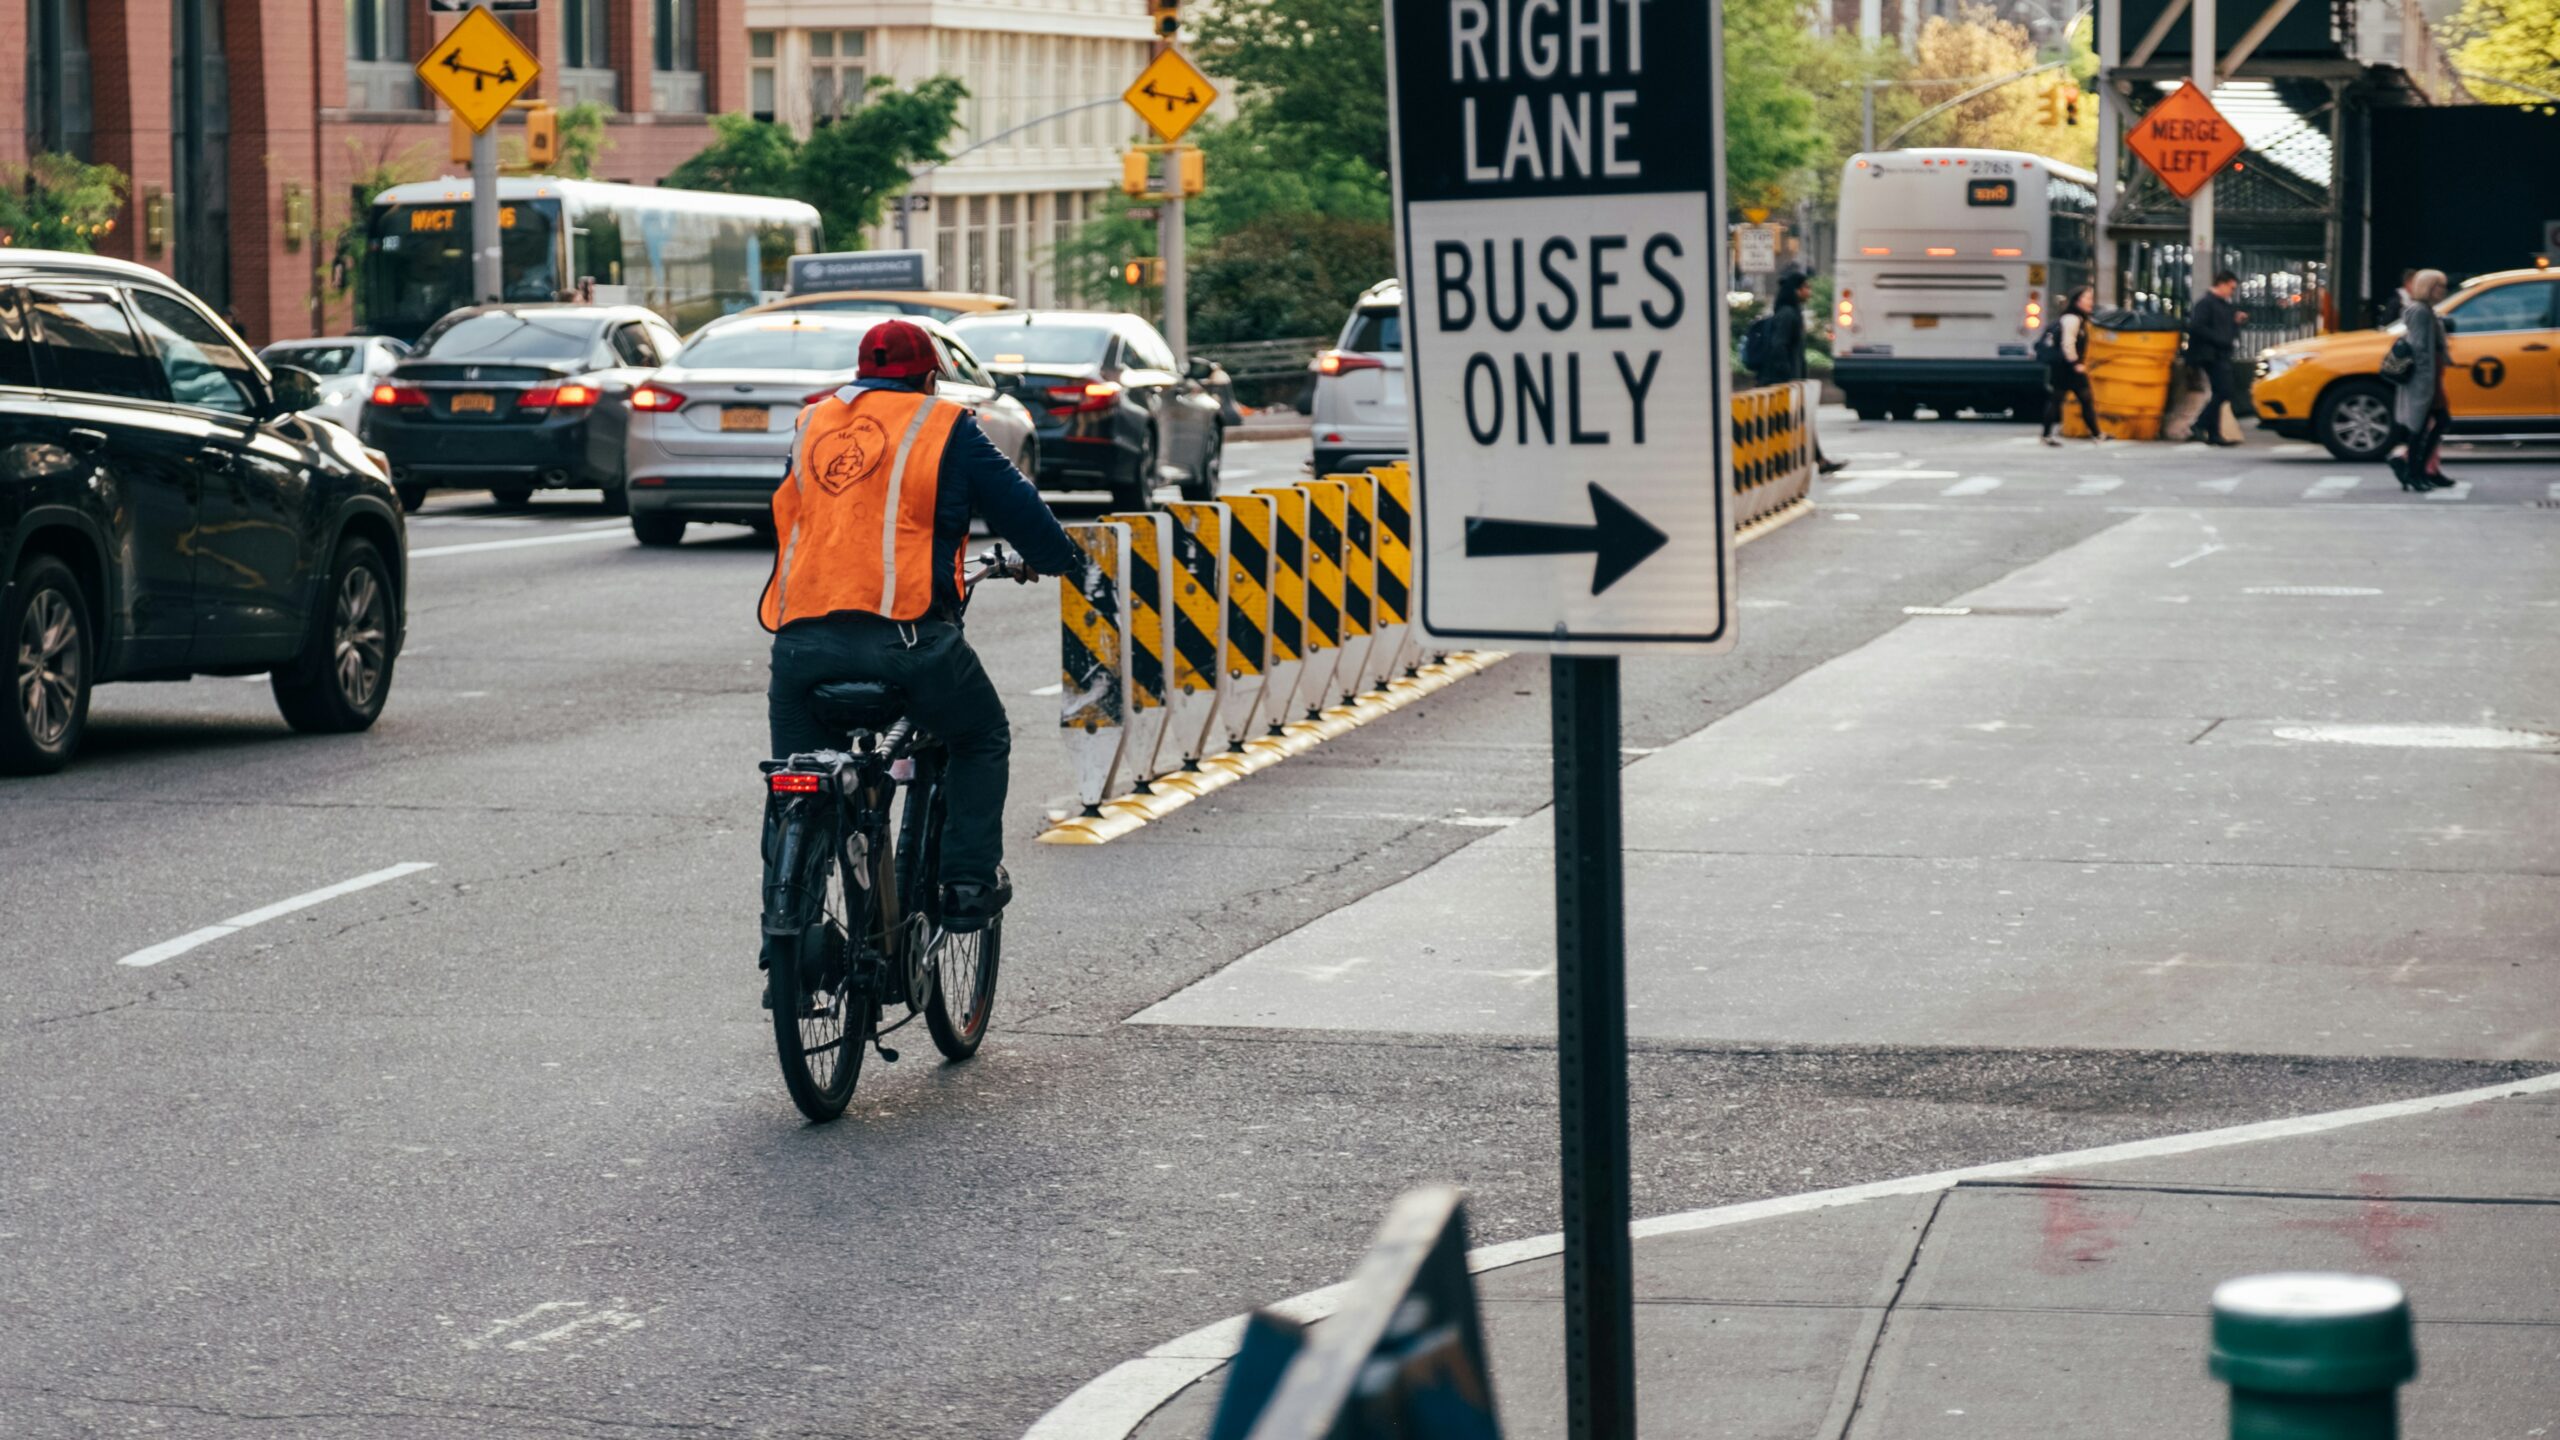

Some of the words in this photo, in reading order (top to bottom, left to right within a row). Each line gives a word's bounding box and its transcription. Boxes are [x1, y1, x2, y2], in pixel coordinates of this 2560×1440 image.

[1449, 0, 1651, 83] RIGHT
[1464, 91, 1641, 182] LANE
[2151, 120, 2222, 142] MERGE
[2161, 151, 2210, 173] LEFT
[1435, 232, 1685, 333] BUSES
[1463, 350, 1662, 446] ONLY
[2478, 362, 2498, 385] T
